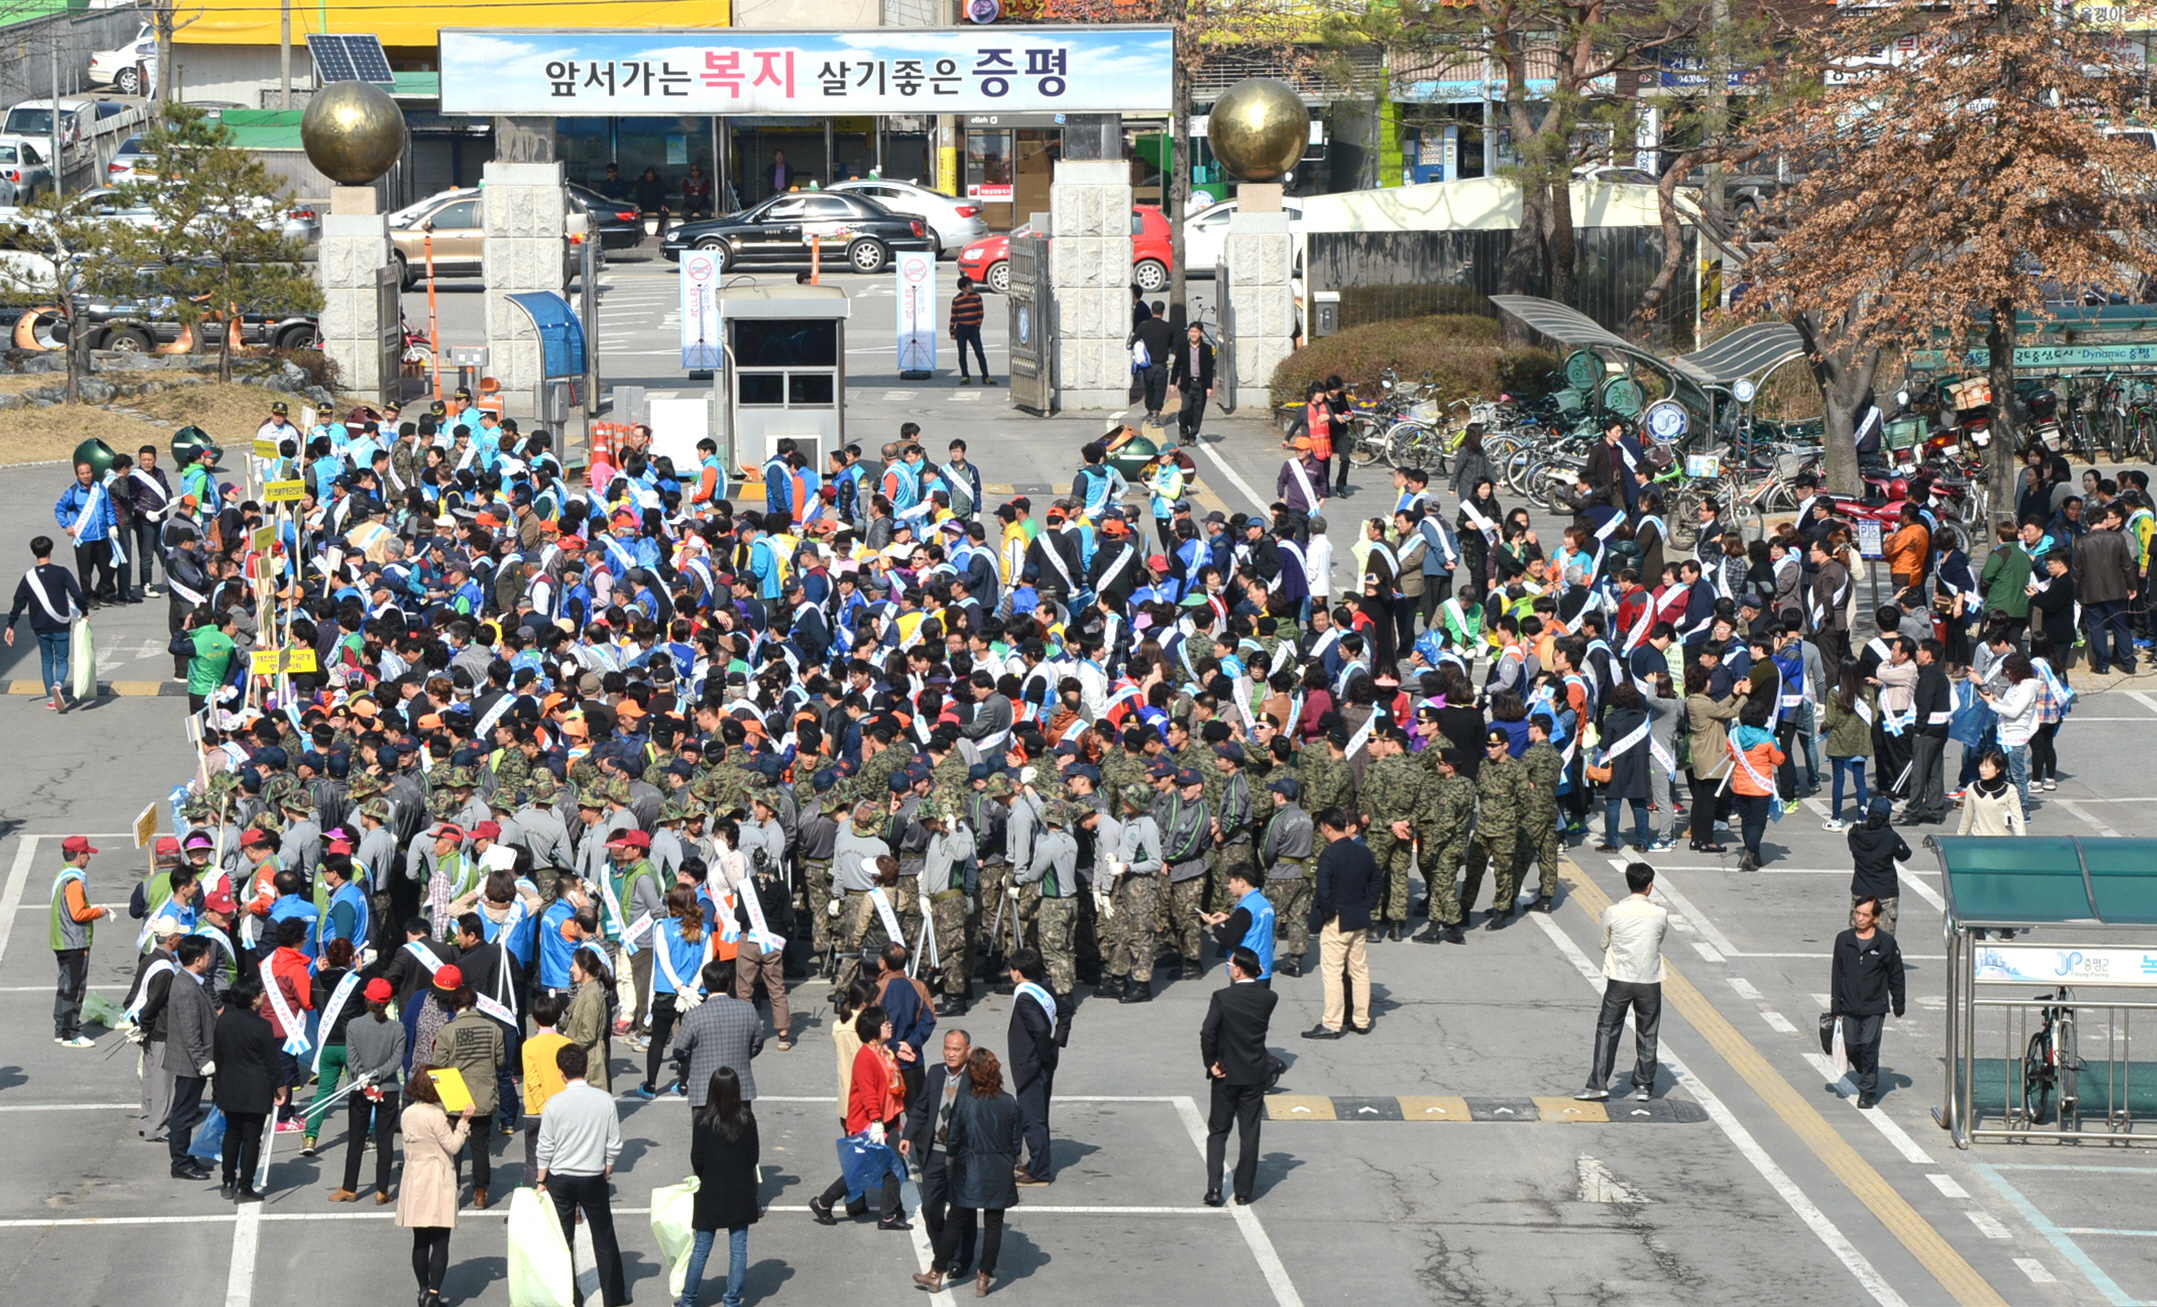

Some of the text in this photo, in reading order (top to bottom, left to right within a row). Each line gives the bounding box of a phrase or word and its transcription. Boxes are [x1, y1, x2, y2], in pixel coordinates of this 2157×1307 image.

[545, 48, 1067, 98] 앞서가는 복지 살기좋은 증평
[2016, 350, 2073, 363] 국토중심도시
[2085, 958, 2109, 972] 증평군
